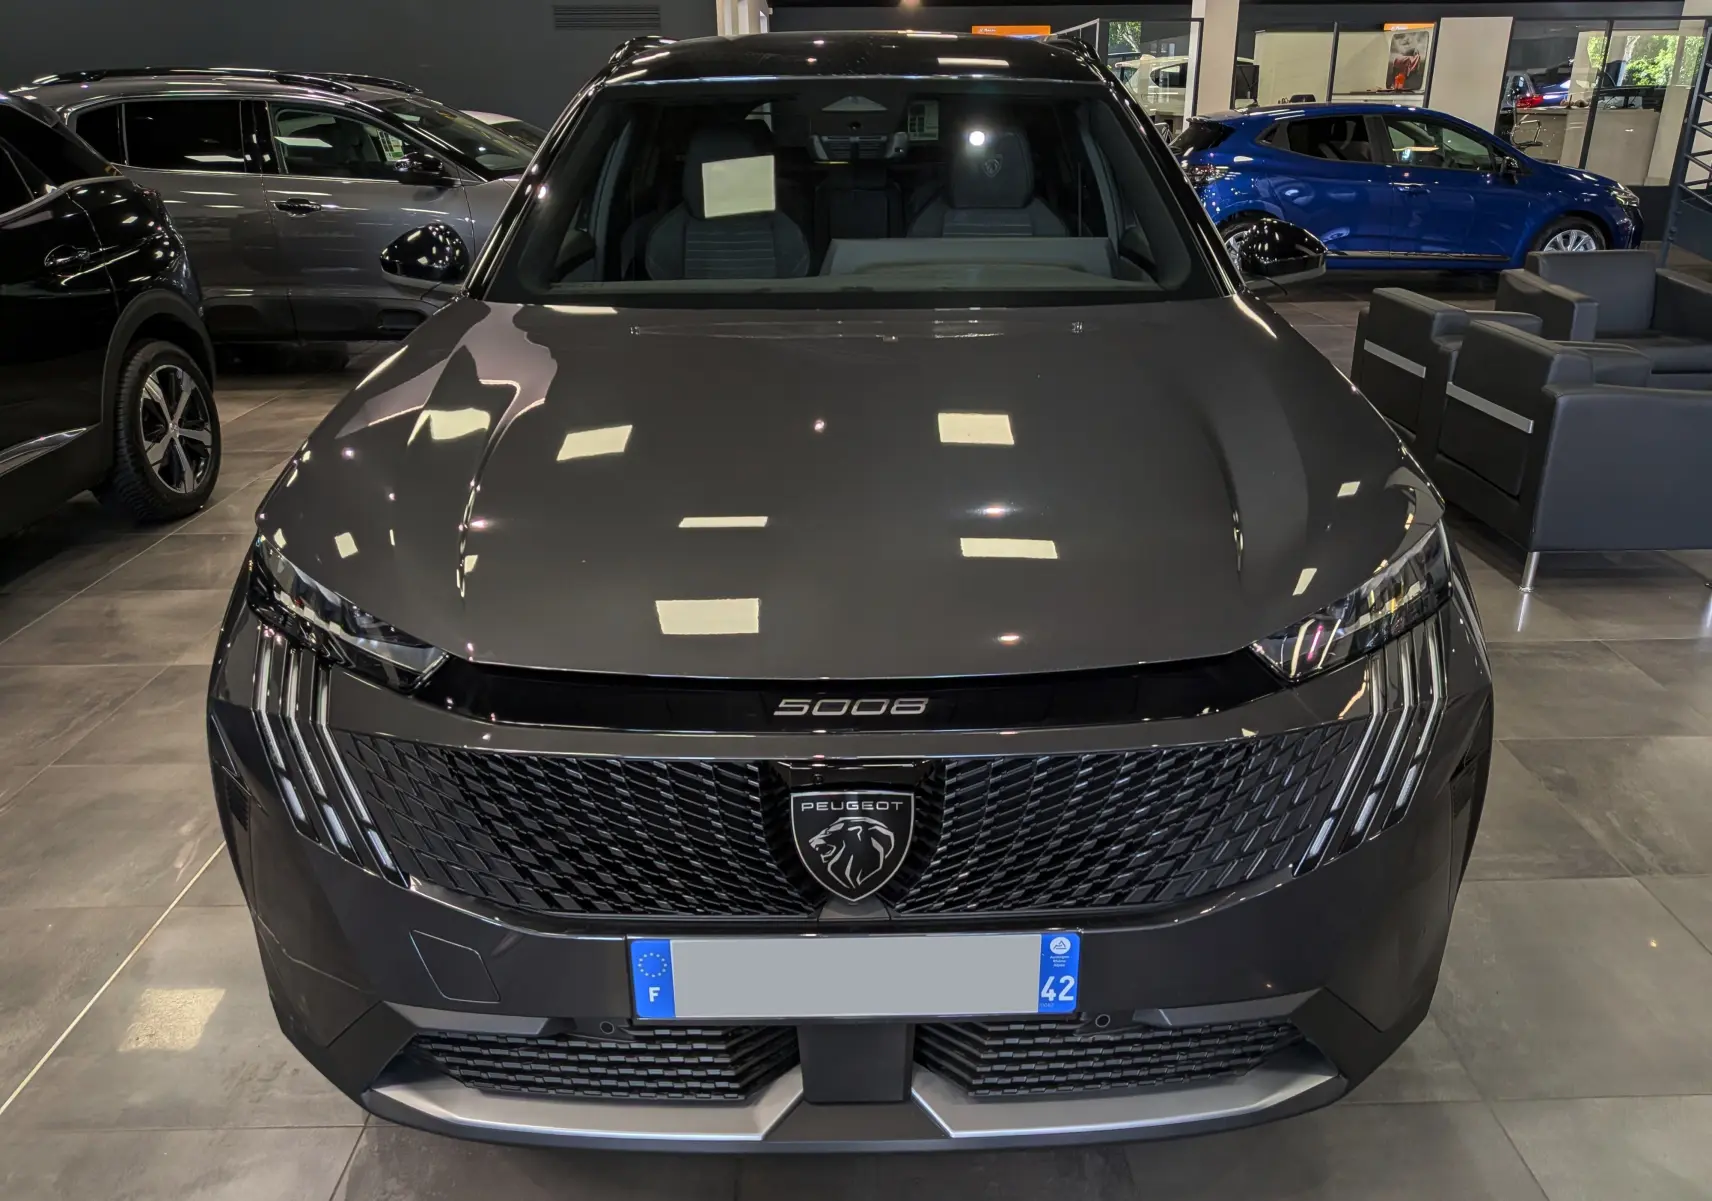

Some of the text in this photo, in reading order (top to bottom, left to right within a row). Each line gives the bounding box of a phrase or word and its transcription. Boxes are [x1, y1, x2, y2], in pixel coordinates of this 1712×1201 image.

[773, 697, 929, 716] 5008
[801, 801, 903, 812] PEUGEOT
[648, 986, 661, 1002] F
[1041, 974, 1074, 1001] 42
